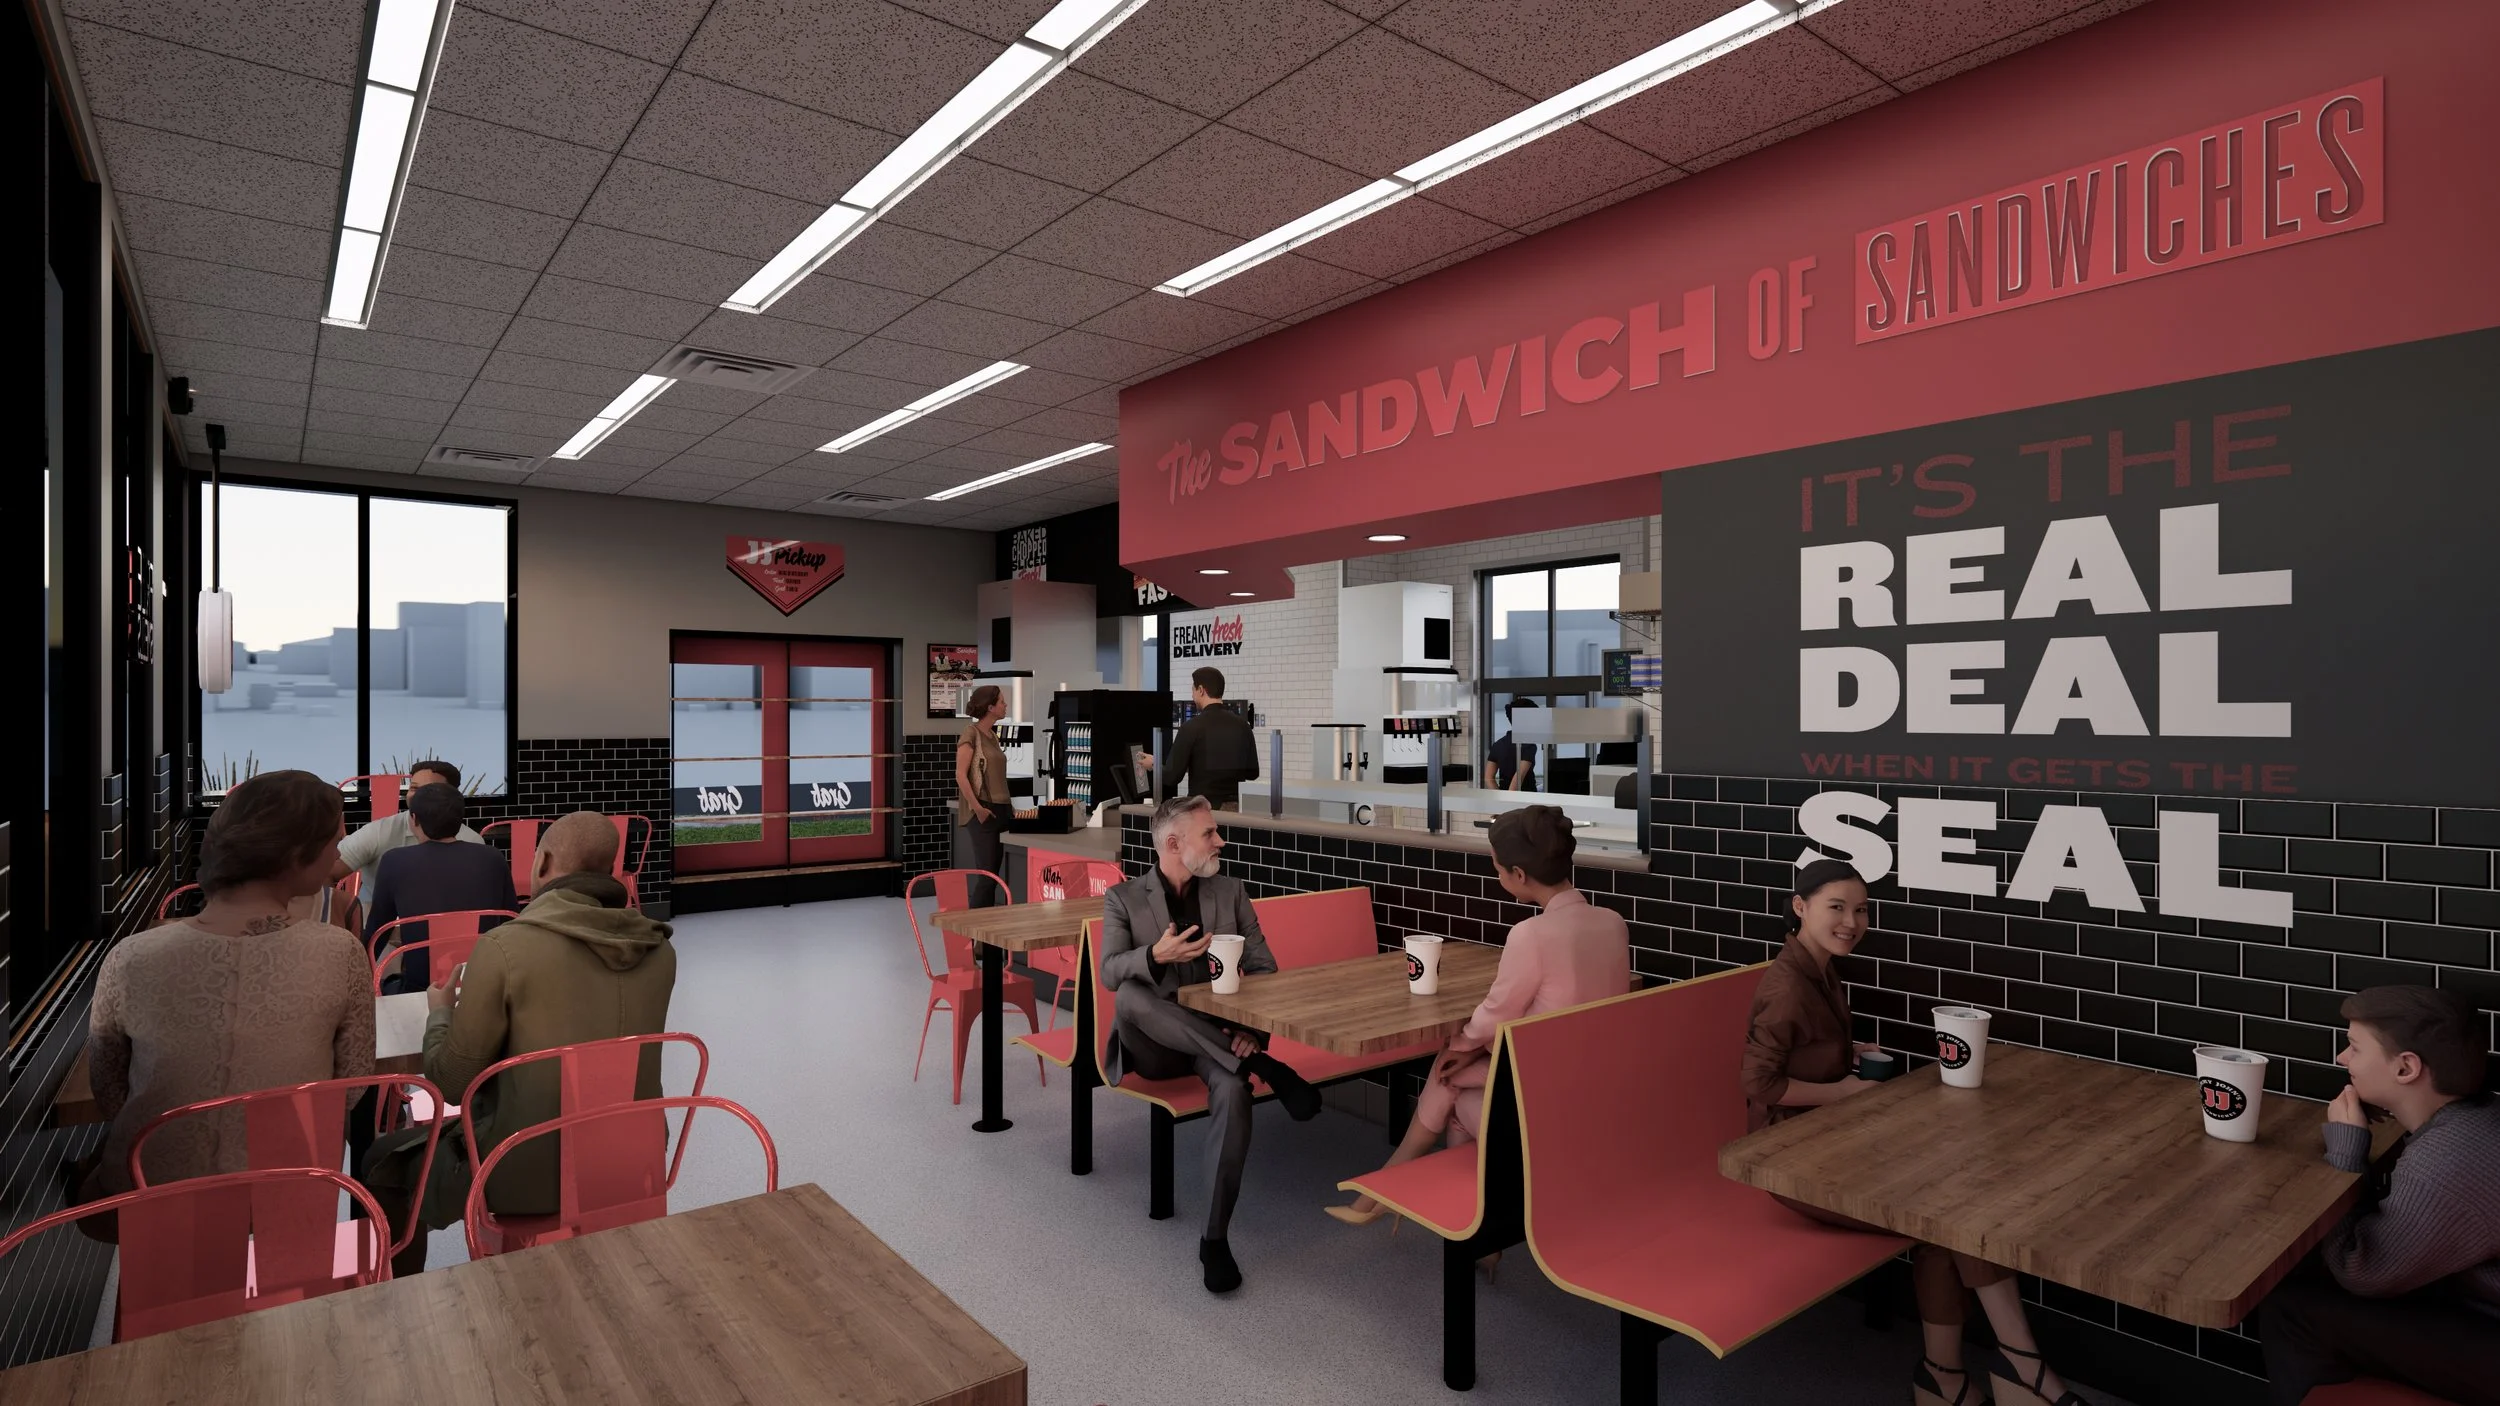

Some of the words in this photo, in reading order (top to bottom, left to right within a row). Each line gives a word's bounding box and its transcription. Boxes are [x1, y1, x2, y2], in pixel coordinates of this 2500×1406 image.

[1157, 438, 1211, 505] The
[1218, 284, 1715, 486] SANDWICH
[1748, 255, 1817, 360] OF
[1866, 95, 2364, 332] SANDWICHES
[1801, 453, 1977, 532] IT'S
[2019, 405, 2292, 503] THE
[746, 540, 772, 565] JJ
[770, 547, 826, 573] Pickup
[1011, 554, 1047, 571] SLICED
[1800, 503, 2293, 631] REAL
[1138, 582, 1174, 605] FAS
[1174, 624, 1211, 645] FREAKY
[1211, 614, 1243, 645] fresh
[1173, 641, 1242, 659] DELIVERY
[1800, 631, 2293, 737] DEAL
[1801, 753, 1934, 780] WHEN
[1949, 756, 1992, 781] IT
[2007, 759, 2151, 790] GETS
[2170, 762, 2298, 793] THE
[1795, 791, 2293, 928] SEAL
[2203, 1086, 2230, 1111] JJ
